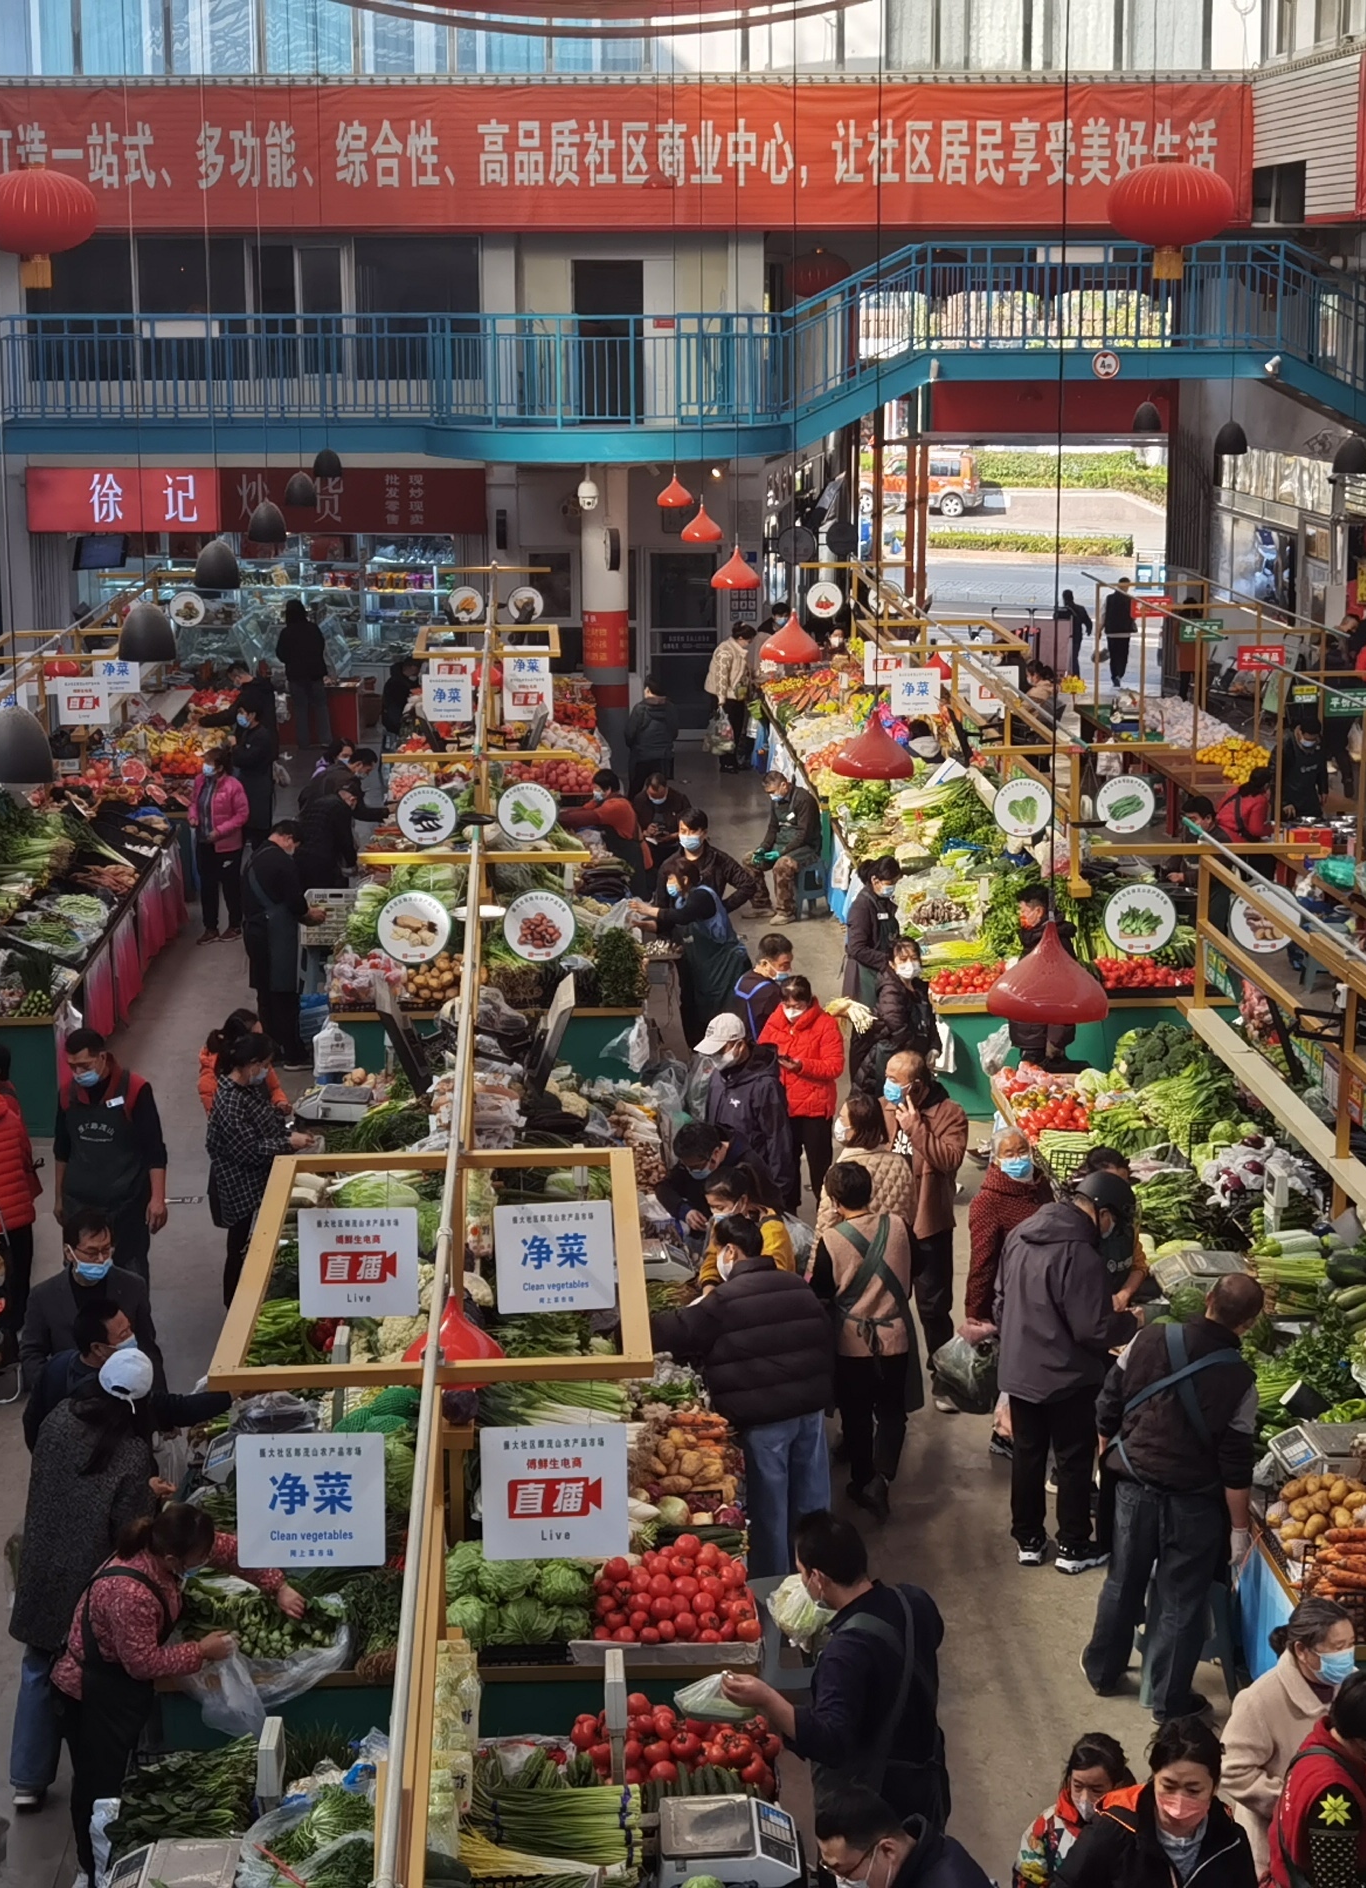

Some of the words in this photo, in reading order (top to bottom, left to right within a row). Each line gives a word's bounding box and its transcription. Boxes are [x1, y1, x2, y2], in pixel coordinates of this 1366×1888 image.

[1099, 359, 1113, 371] 4m
[102, 661, 130, 677] 净菜
[513, 658, 539, 673] 净菜
[432, 687, 462, 704] 净菜
[901, 681, 930, 697] 净菜
[520, 1233, 589, 1271] 净菜
[324, 1253, 384, 1282] 直播
[522, 1281, 544, 1292] Clean
[546, 1279, 590, 1293] vegetables
[346, 1292, 372, 1303] Live
[268, 1469, 354, 1516] 净菜
[513, 1481, 587, 1515] 直播
[270, 1529, 296, 1541] Clean
[299, 1528, 354, 1543] vegetables
[540, 1529, 571, 1541] Live
